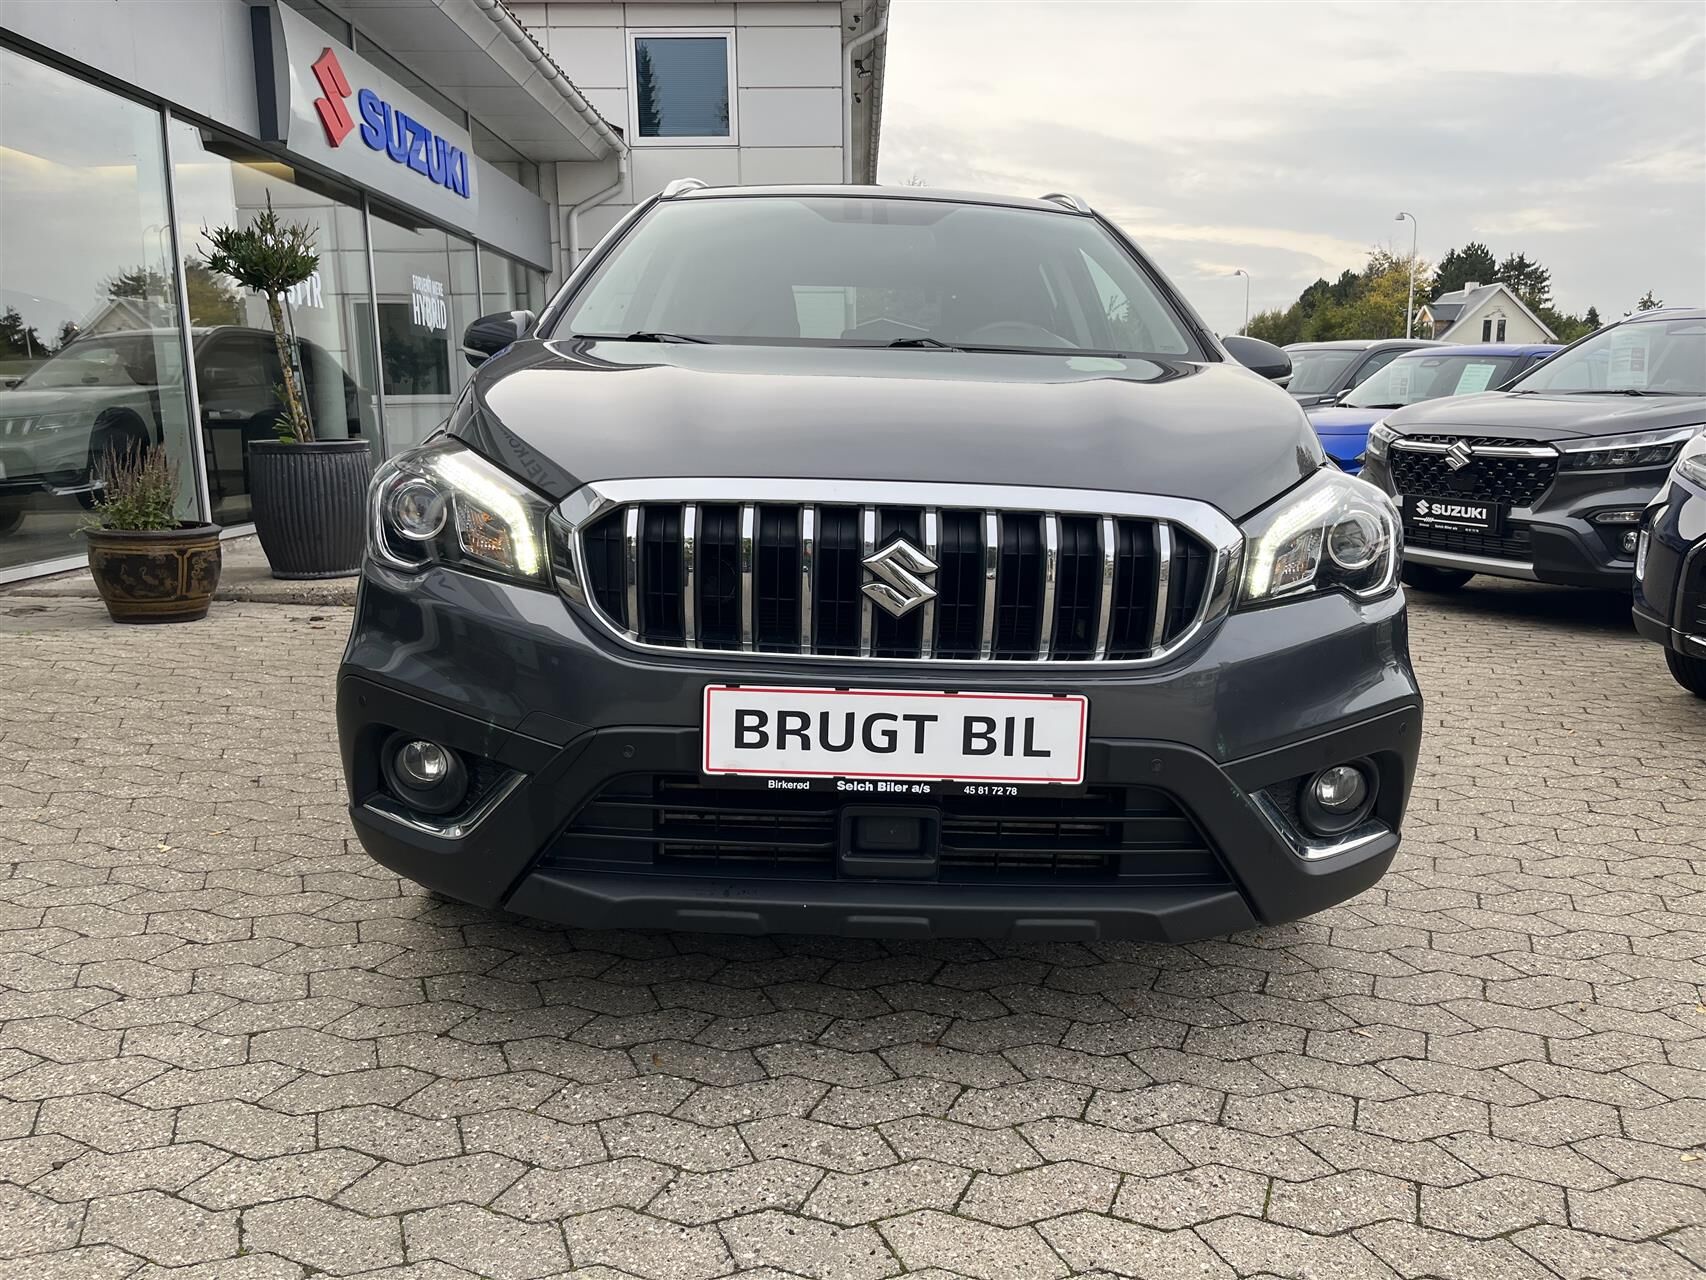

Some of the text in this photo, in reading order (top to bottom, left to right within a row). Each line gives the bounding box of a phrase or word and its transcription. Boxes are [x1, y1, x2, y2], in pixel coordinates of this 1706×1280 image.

[358, 88, 470, 199] SUZUKI
[412, 292, 447, 330] HYBRID
[1431, 503, 1487, 519] SUZUKI
[734, 708, 1051, 758] BRUGT BIL
[768, 779, 1018, 796] Birkerød Selch Biler a/s 45 81 72 78
